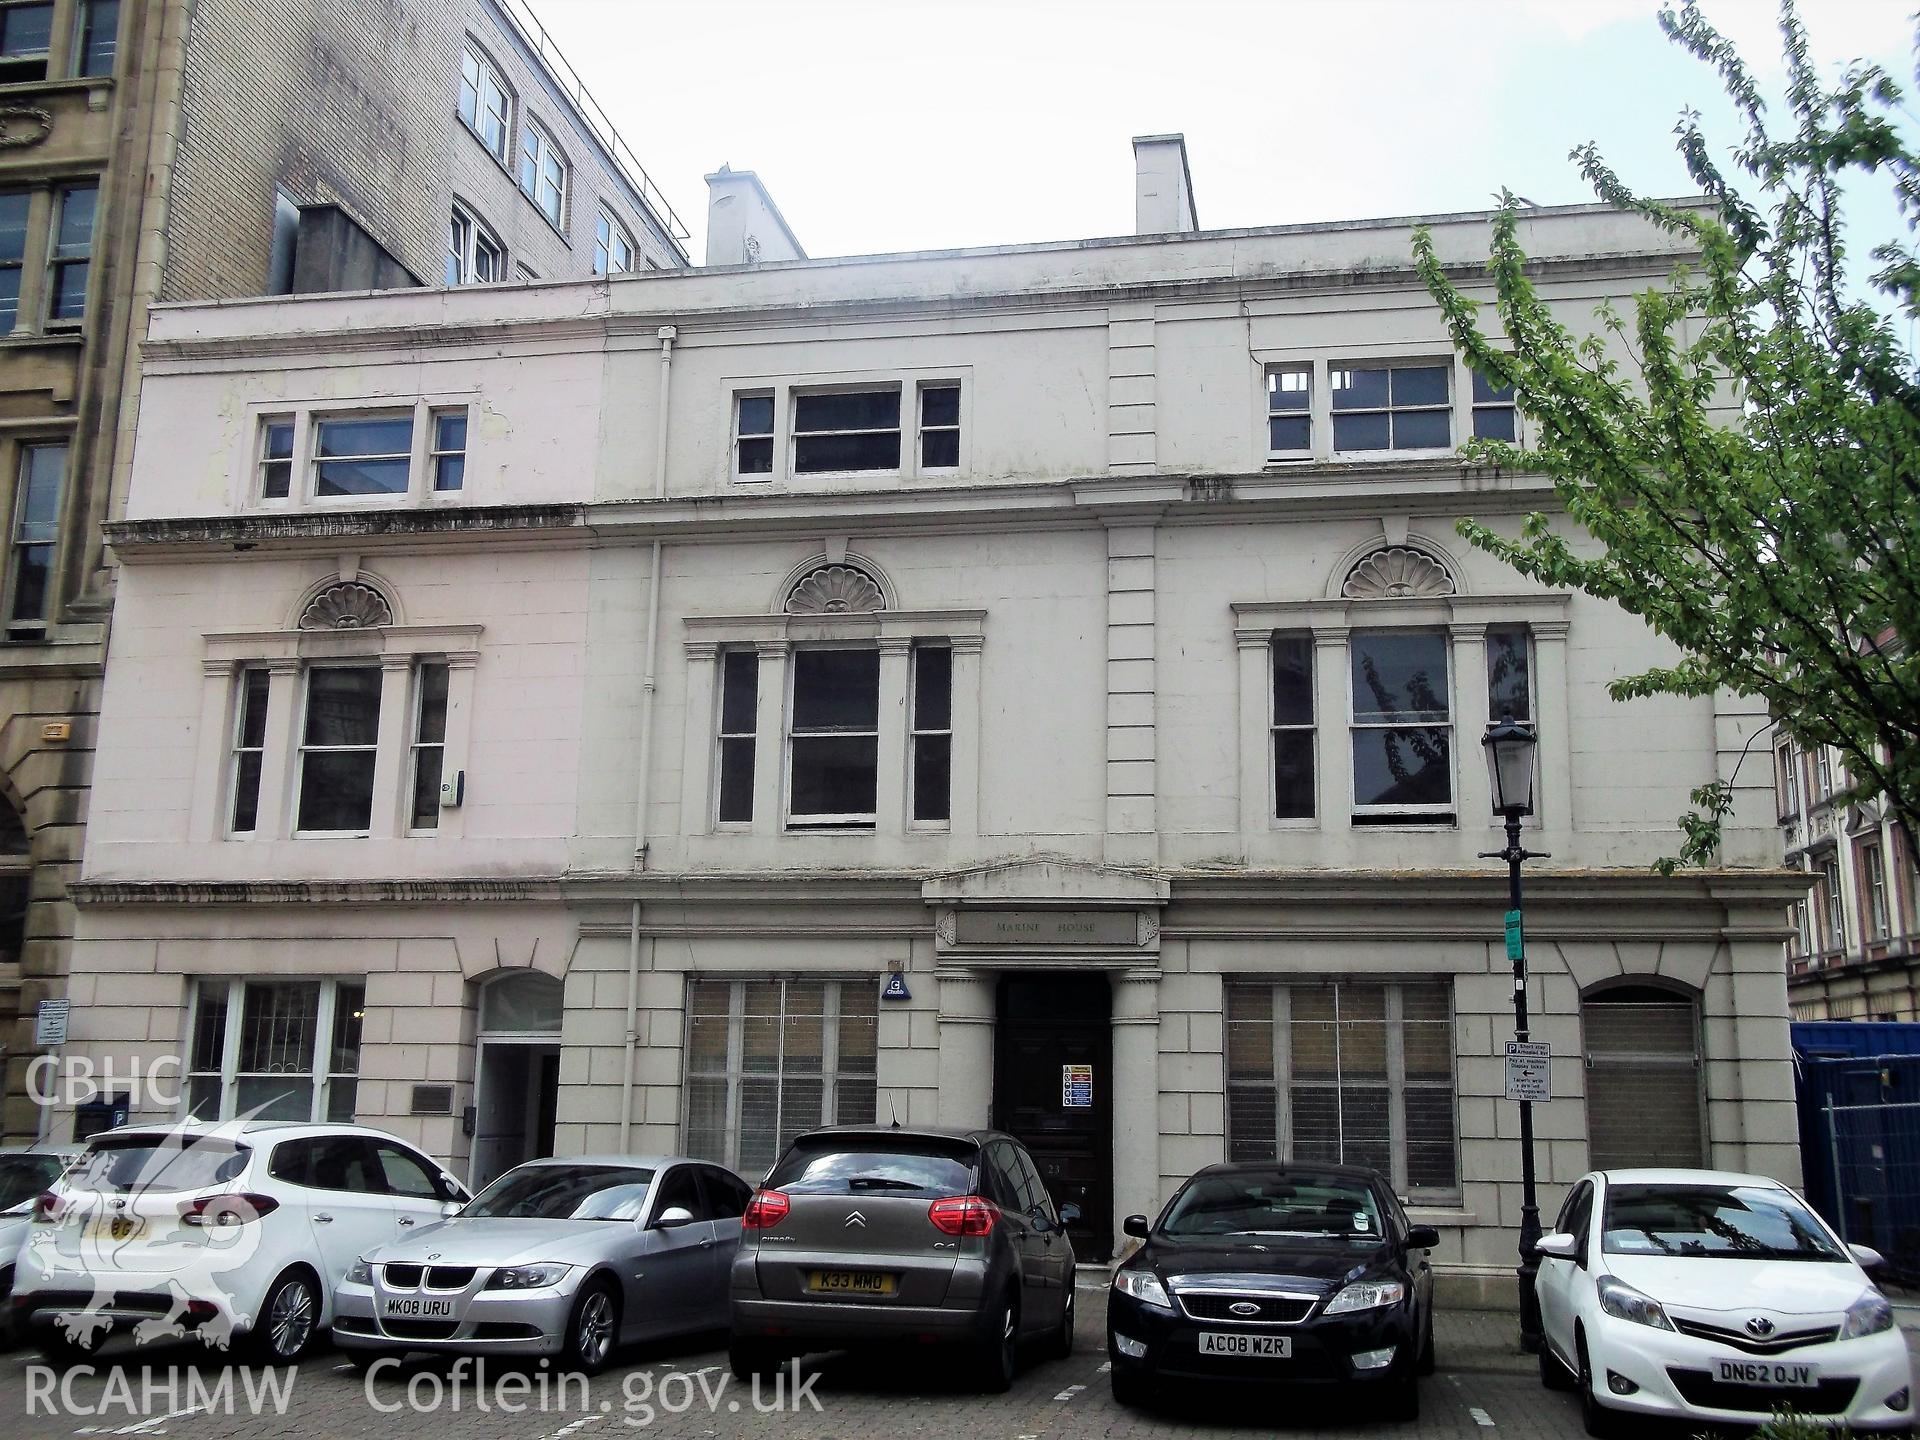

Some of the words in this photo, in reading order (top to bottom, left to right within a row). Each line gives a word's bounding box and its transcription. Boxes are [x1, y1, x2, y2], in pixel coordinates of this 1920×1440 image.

[996, 922, 1040, 933] MARINE
[1057, 922, 1095, 933] HOUSE
[820, 1272, 850, 1288] K33
[853, 1274, 883, 1290] MMO
[388, 1299, 420, 1315] MK08
[423, 1300, 451, 1316] URU
[1206, 1335, 1248, 1353] AC08
[1252, 1337, 1284, 1355] WZR
[1720, 1363, 1771, 1382] DN62
